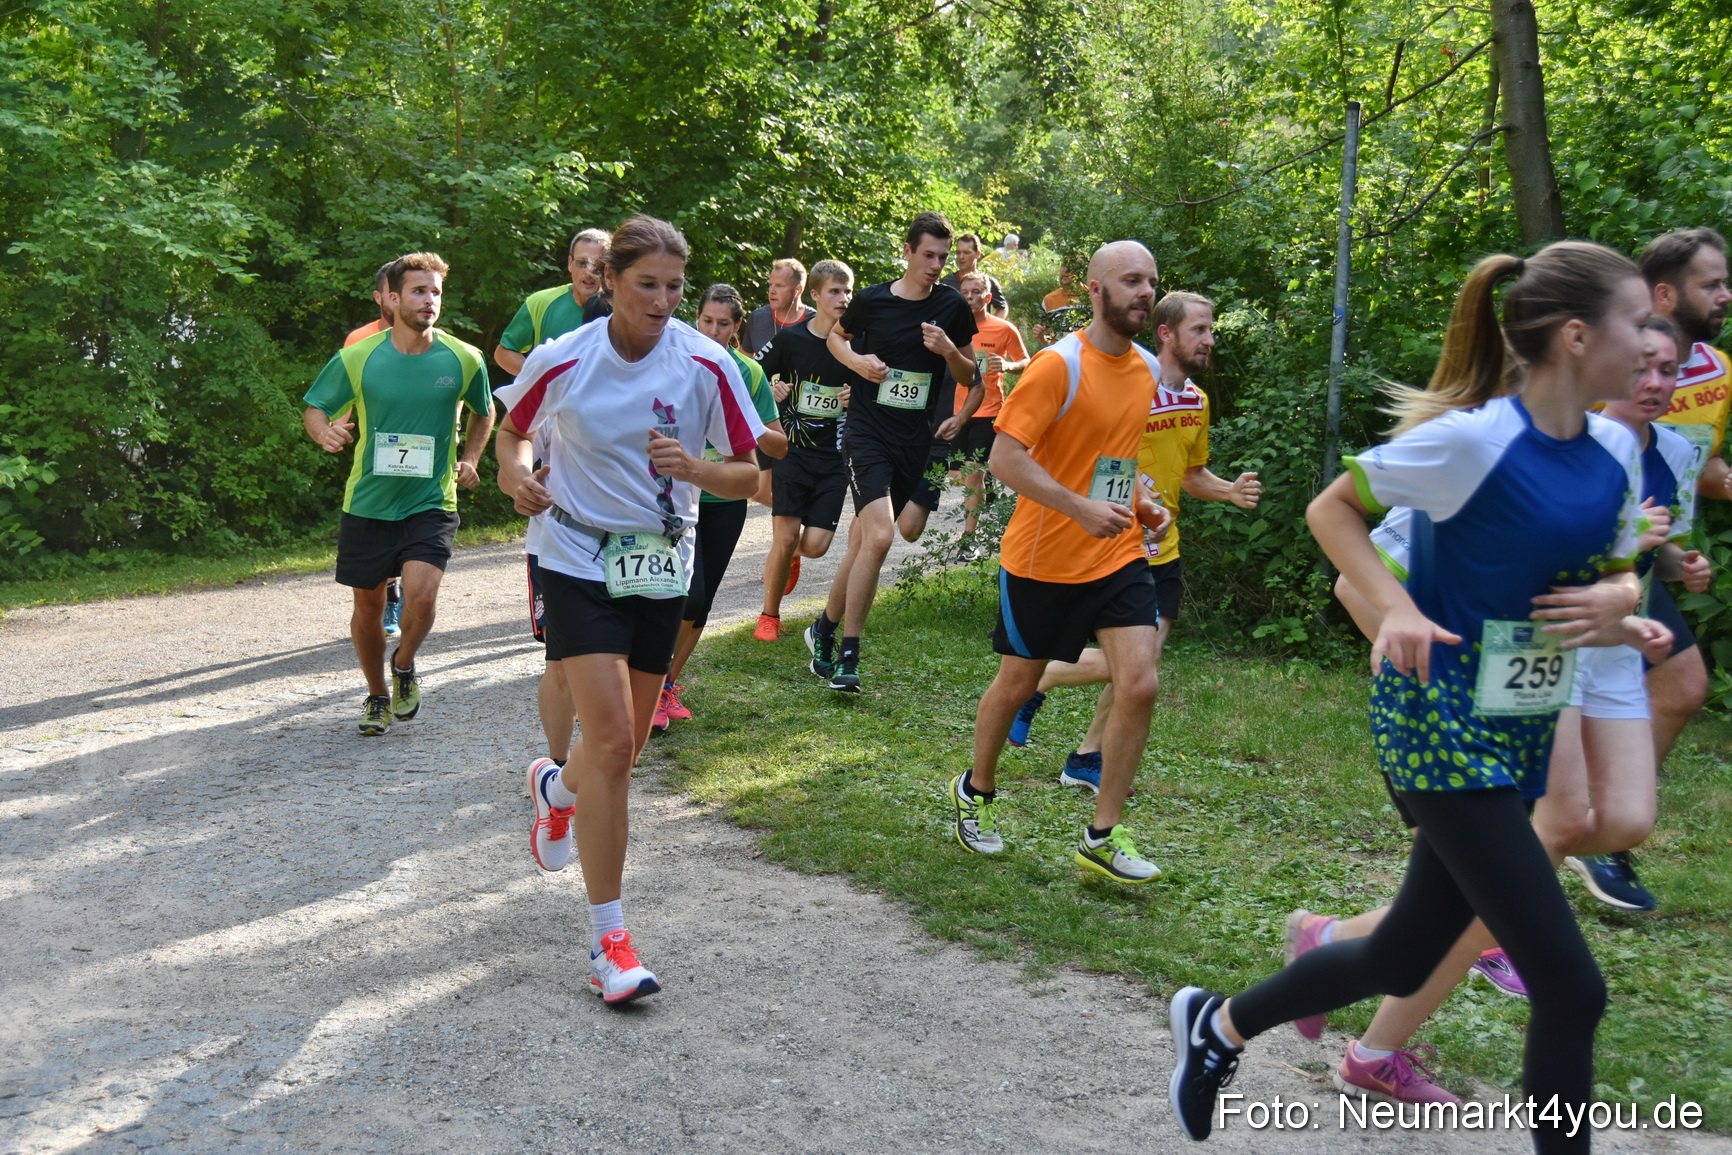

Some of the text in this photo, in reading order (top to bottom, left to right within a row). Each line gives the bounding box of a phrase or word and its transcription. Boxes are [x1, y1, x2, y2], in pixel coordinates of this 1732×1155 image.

[434, 375, 456, 386] AOK
[889, 383, 919, 399] 439
[806, 394, 839, 409] 1750
[1664, 395, 1691, 416] AX
[1145, 412, 1202, 433] MAX BÖG
[398, 449, 409, 464] 7
[1106, 478, 1131, 499] 112
[615, 554, 677, 578] 1784
[615, 576, 679, 587] Lippmann Alexandra
[1503, 654, 1565, 690] 259
